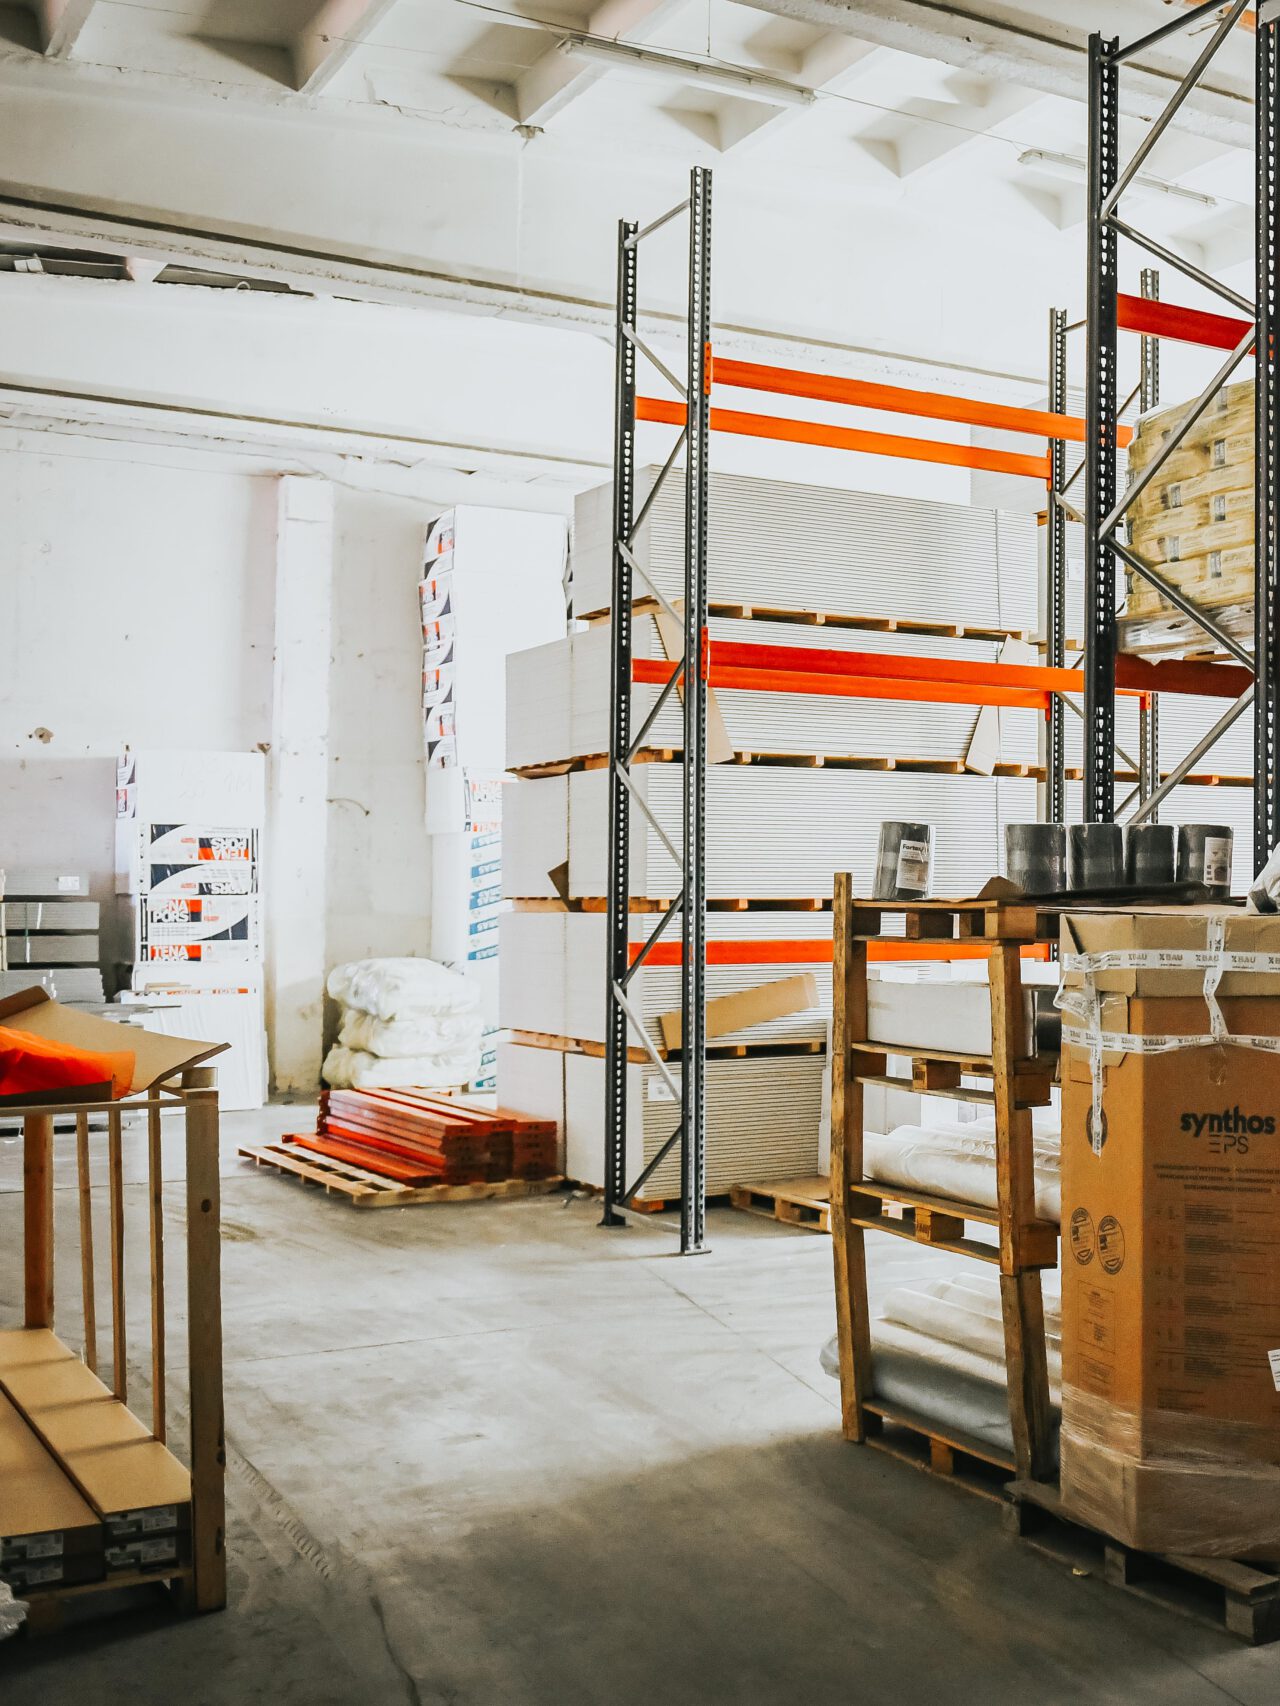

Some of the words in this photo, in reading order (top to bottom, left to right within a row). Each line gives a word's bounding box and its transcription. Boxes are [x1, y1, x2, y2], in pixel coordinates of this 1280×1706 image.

[153, 945, 189, 958] TENA
[1180, 1105, 1276, 1137] synthos
[1209, 1134, 1249, 1154] EPS
